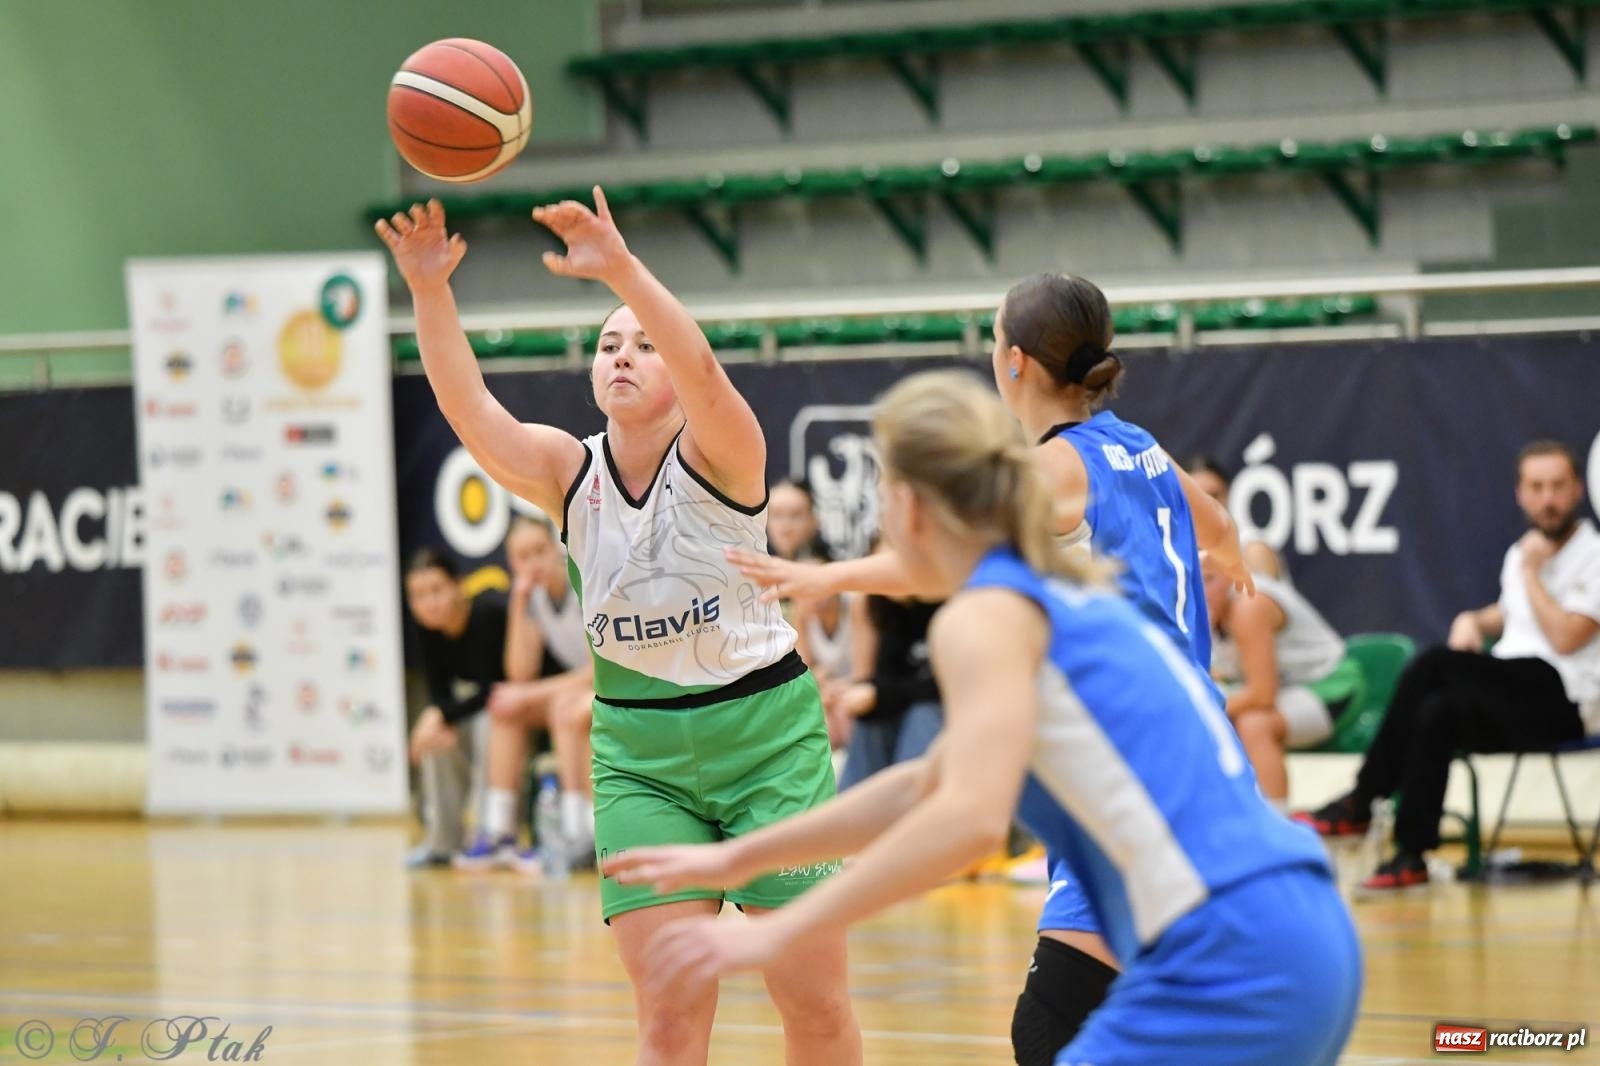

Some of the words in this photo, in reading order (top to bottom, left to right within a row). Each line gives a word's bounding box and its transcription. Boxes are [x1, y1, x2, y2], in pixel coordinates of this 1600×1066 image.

[433, 444, 540, 557] O
[1229, 433, 1399, 556] ÓRZ
[613, 595, 720, 642] Clavis
[1157, 508, 1189, 634] 1
